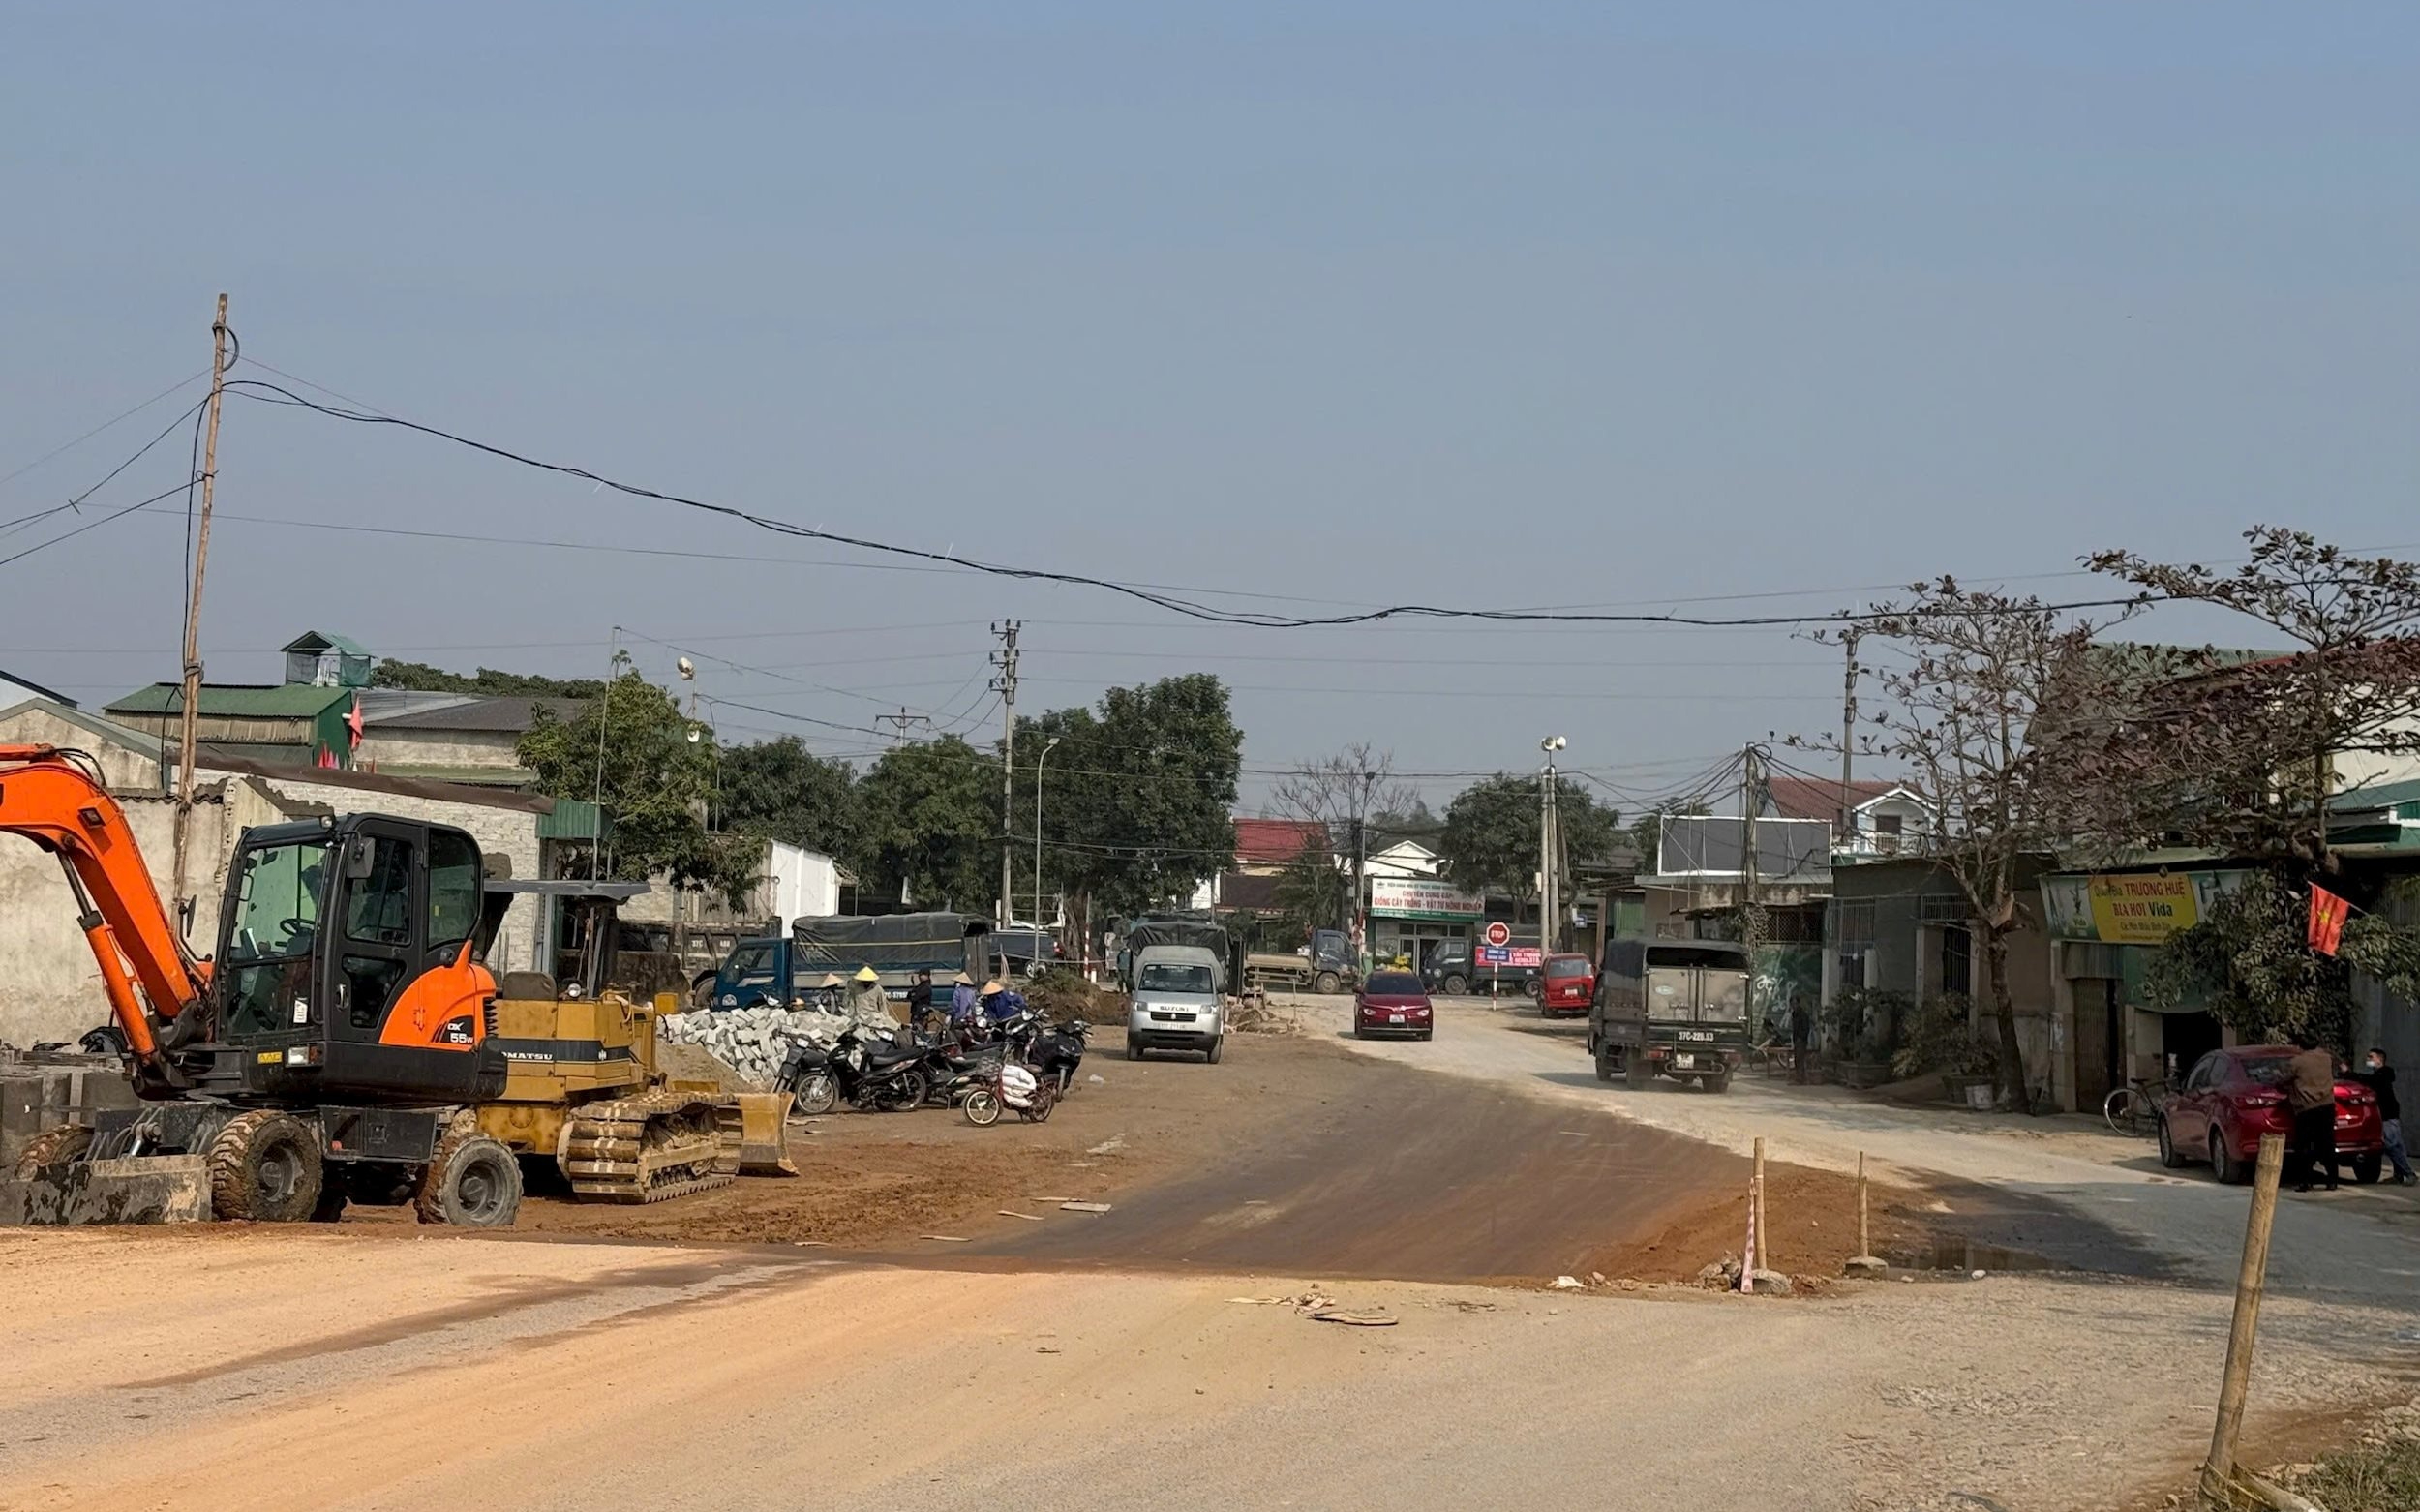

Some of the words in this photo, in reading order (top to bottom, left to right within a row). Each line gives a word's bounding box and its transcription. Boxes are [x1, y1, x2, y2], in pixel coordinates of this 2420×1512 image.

[2112, 902, 2129, 916] BIA
[2148, 901, 2173, 917] Vida
[500, 1051, 553, 1060] MATSU
